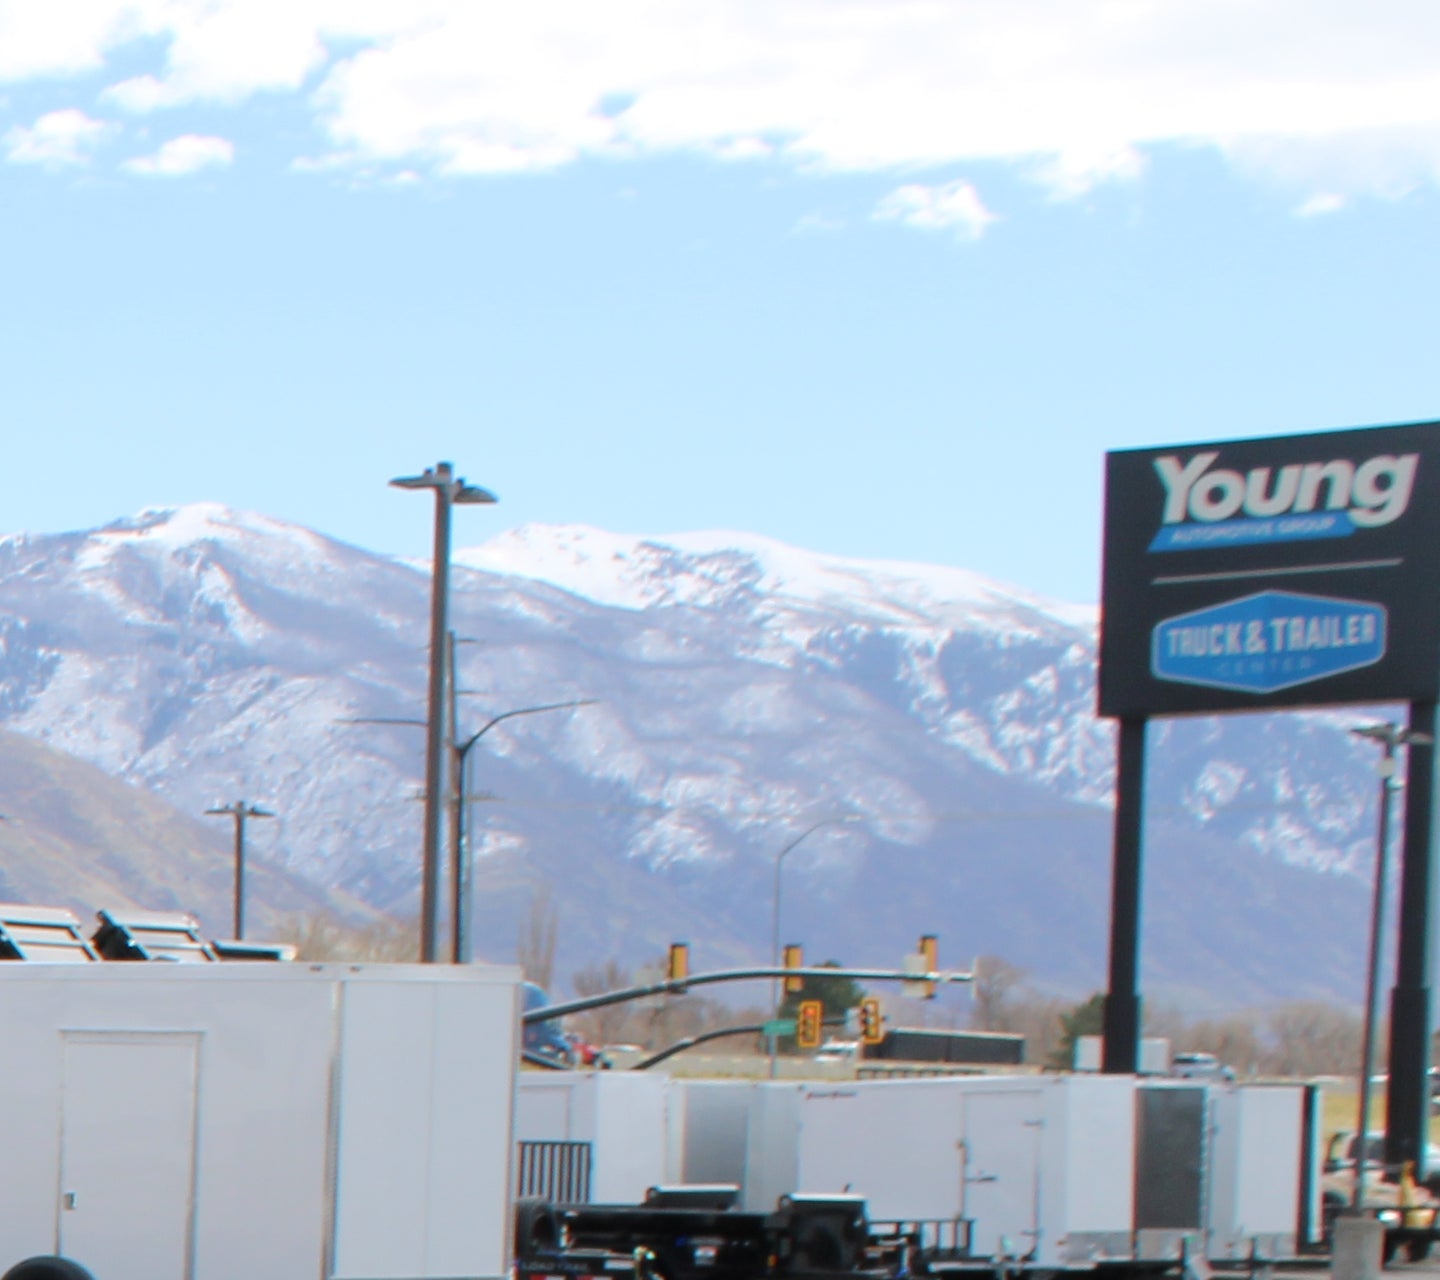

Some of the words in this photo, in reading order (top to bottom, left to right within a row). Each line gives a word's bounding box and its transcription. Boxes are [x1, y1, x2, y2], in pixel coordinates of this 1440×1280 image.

[1153, 451, 1420, 528] Young
[1171, 522, 1274, 543] AUTOMOTIVE
[1277, 517, 1336, 534] GROUP
[1167, 622, 1242, 658] TRUCK
[1244, 619, 1267, 654] &
[1270, 613, 1376, 652] TRAILER
